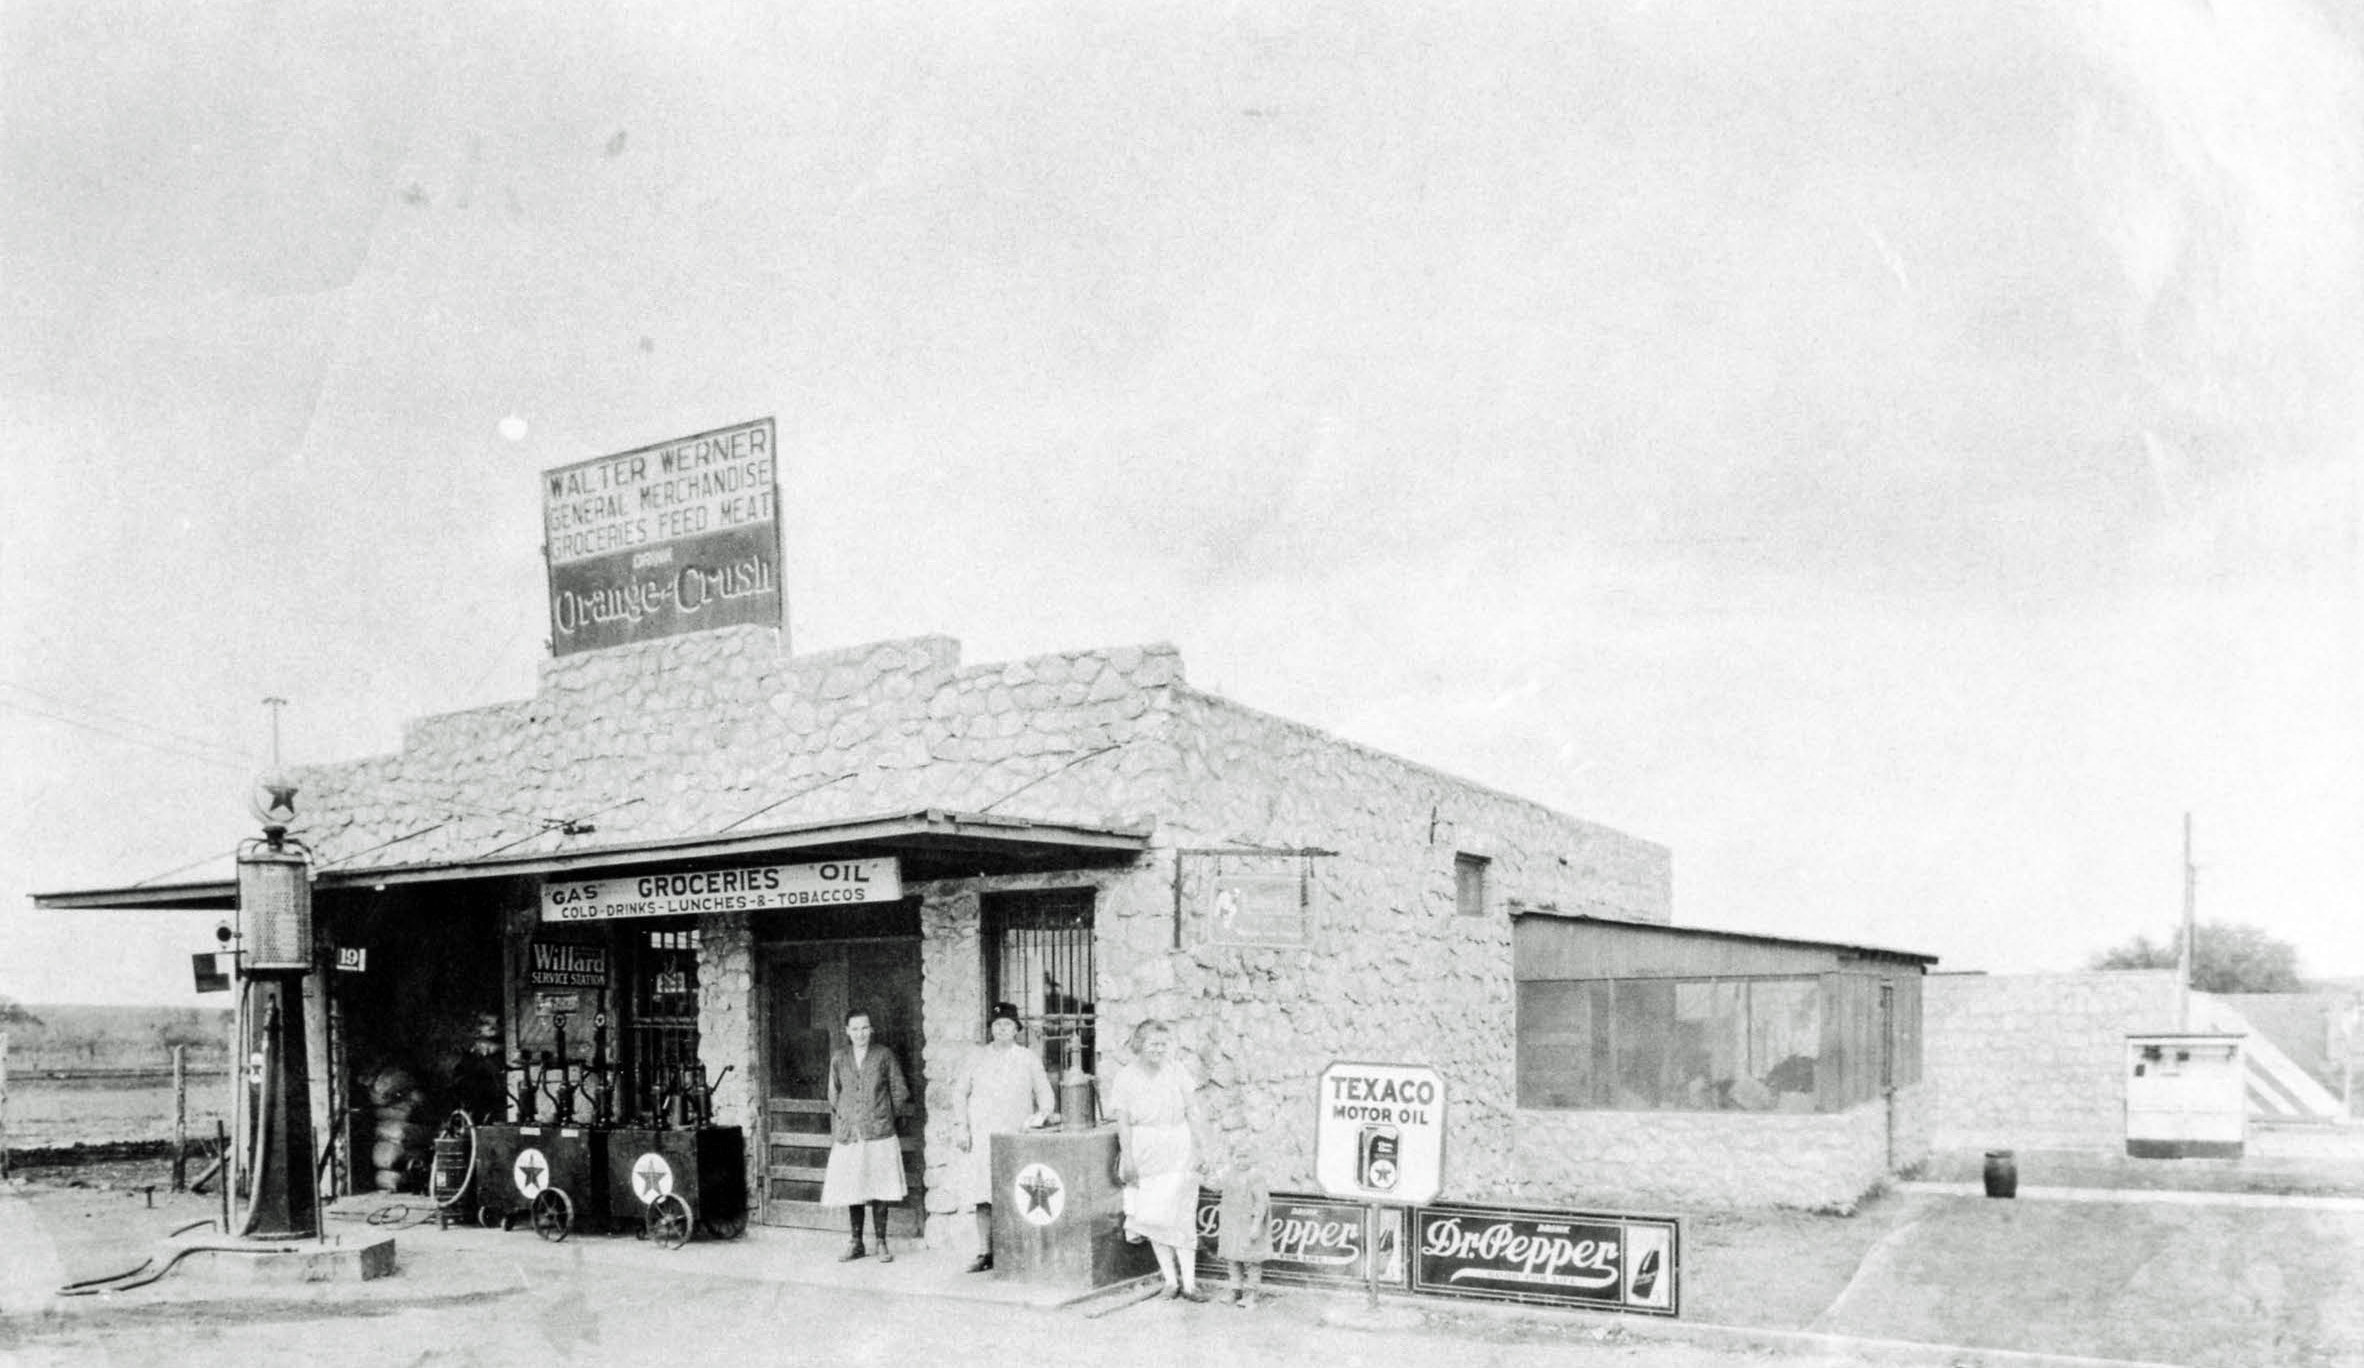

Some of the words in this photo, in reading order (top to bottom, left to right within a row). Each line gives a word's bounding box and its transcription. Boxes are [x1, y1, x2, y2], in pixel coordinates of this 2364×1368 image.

[550, 457, 646, 498] WALTER
[660, 428, 767, 474] WERNER
[551, 494, 630, 532] GENERAL
[640, 460, 769, 511] MERCHANDISE
[552, 518, 648, 559] GROCERIES
[658, 505, 707, 538] FEED
[720, 491, 770, 526] MEAT
[637, 867, 780, 899] GROCERIES
[534, 944, 606, 973] Willard
[531, 971, 569, 985] SERVICE
[570, 973, 606, 986] STATION
[1330, 1076, 1434, 1105] TEXACO
[1333, 1105, 1393, 1122] MOTOR
[1399, 1109, 1429, 1125] OIL
